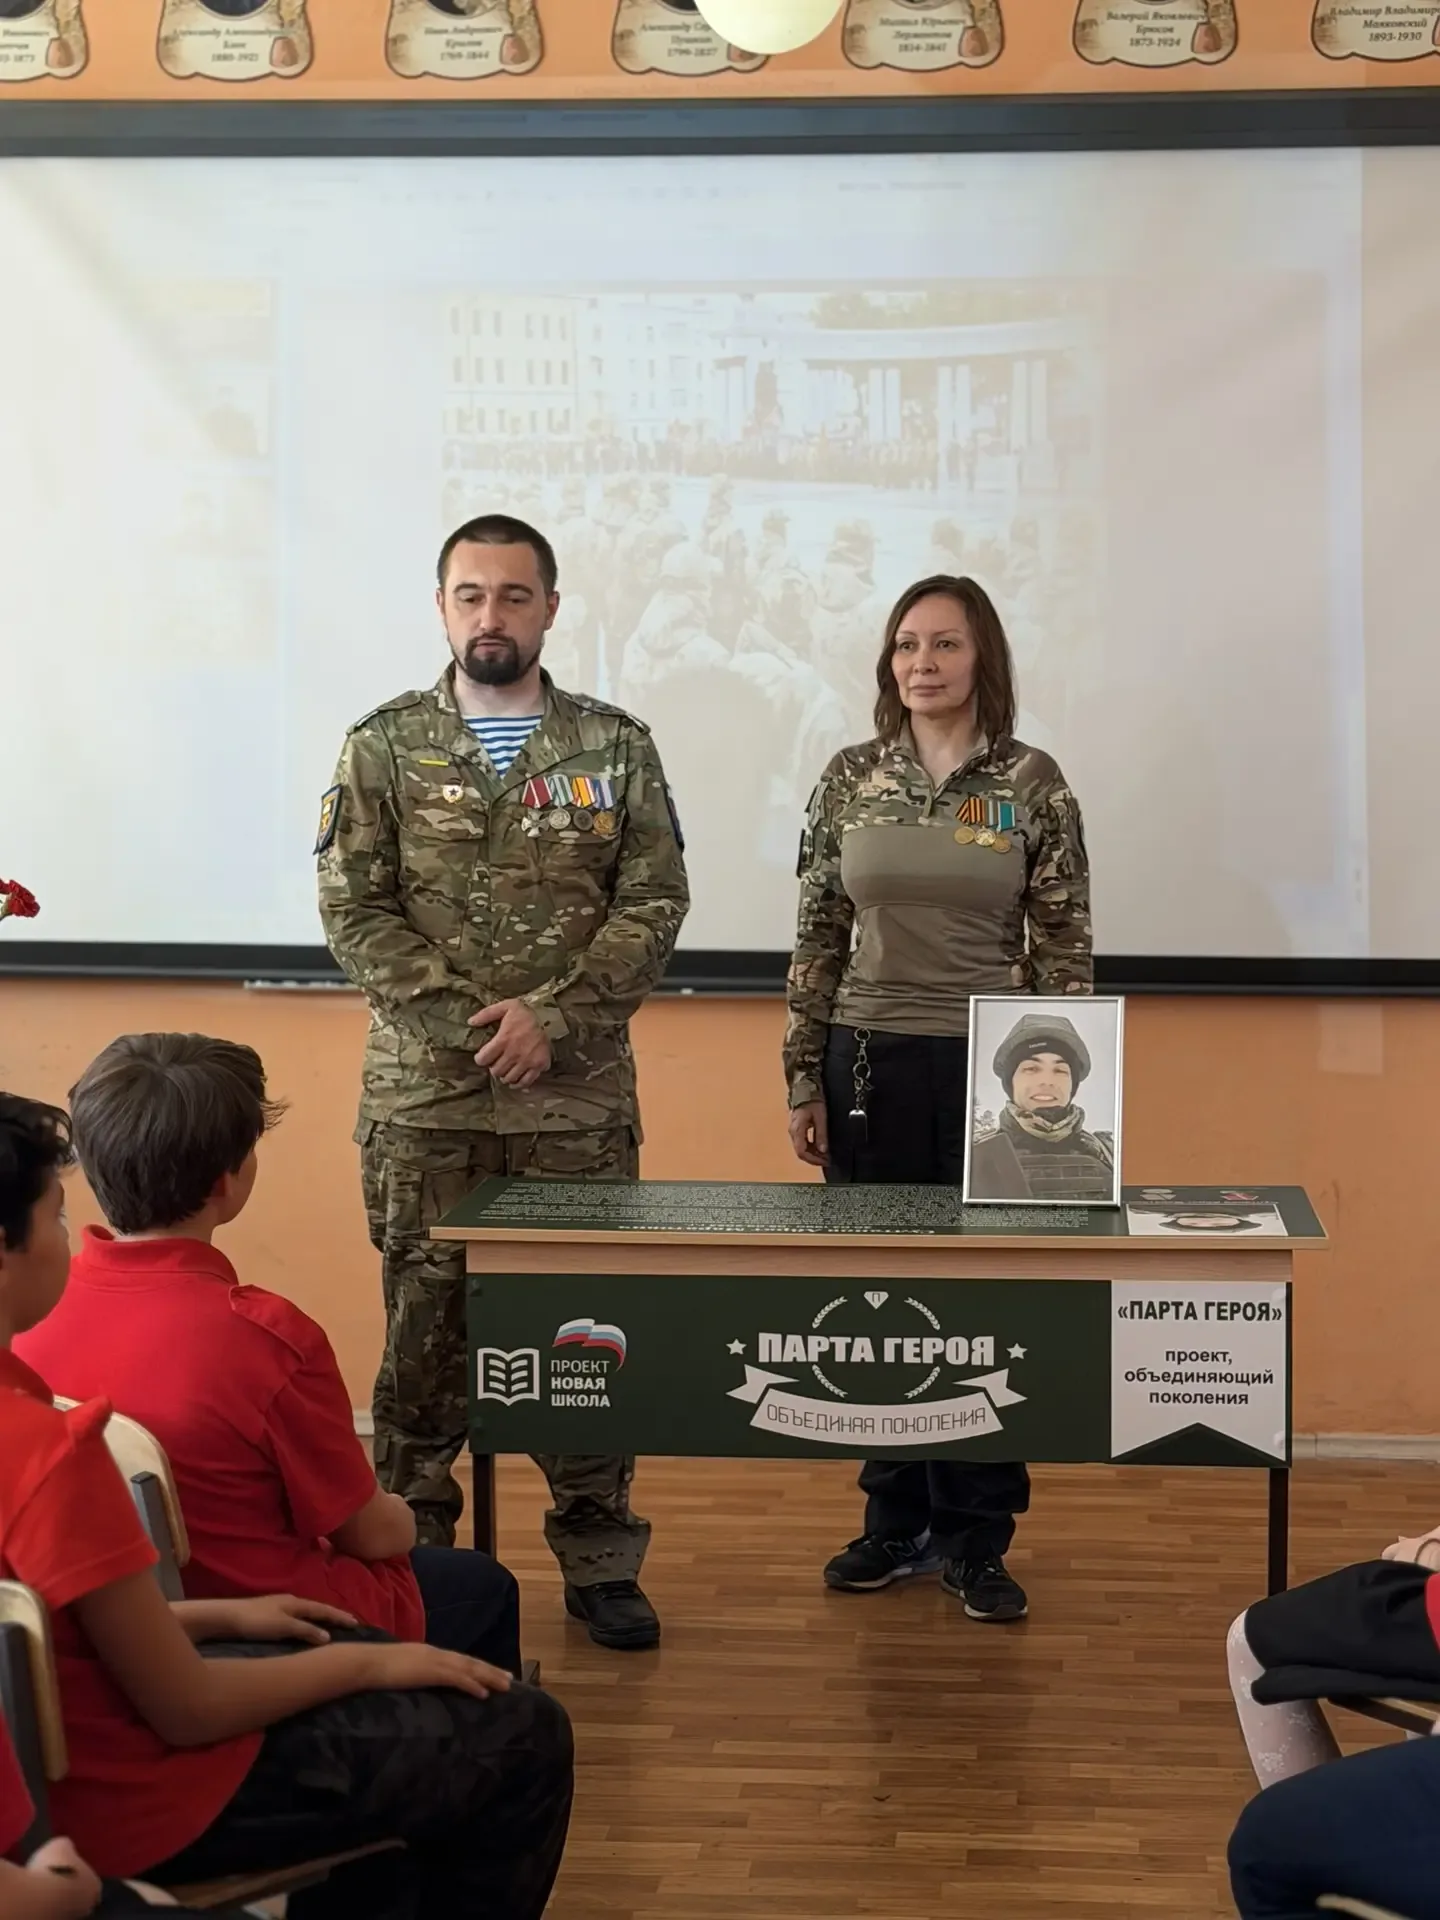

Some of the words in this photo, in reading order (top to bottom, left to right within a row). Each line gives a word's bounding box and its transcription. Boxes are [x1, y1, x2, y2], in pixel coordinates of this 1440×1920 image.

[1363, 18, 1428, 29] Маяковский
[1368, 31, 1422, 42] 1893-1930
[1117, 1301, 1198, 1320] «ПАРТА
[1204, 1301, 1283, 1321] ГЕРОЯ»
[758, 1332, 875, 1363] ПАРТА
[883, 1335, 995, 1367] ГЕРОЯ
[1165, 1350, 1233, 1364] проект,
[550, 1360, 610, 1373] ПРОЕКТ
[1124, 1367, 1274, 1386] объединяющий
[551, 1377, 606, 1390] НОВАЯ
[551, 1394, 611, 1407] ШКОЛА
[1149, 1391, 1249, 1404] поколения
[881, 1406, 986, 1435] ПОКОЛЕНИЯ
